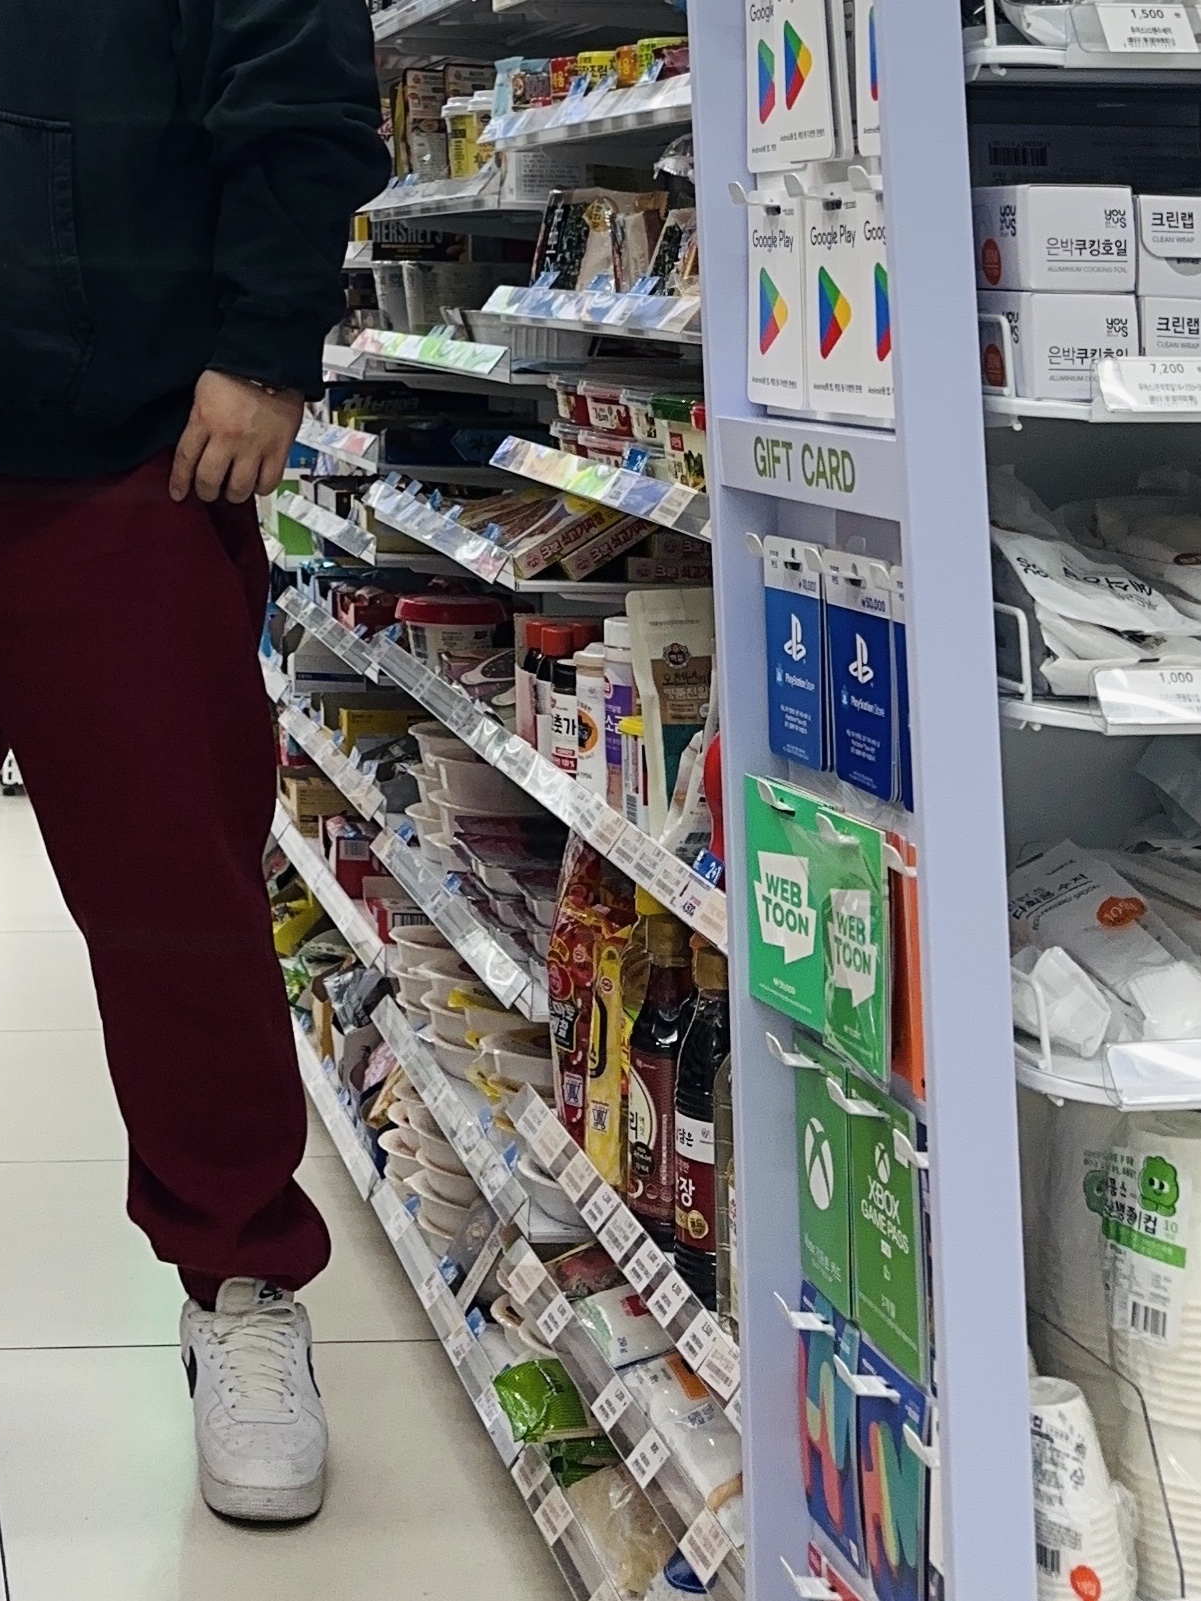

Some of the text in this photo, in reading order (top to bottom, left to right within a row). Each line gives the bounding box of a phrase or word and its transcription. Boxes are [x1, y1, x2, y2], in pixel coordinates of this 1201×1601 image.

[1130, 8, 1165, 20] 1,500
[863, 220, 887, 245] Goog
[1150, 211, 1195, 231] 크린랩
[752, 229, 794, 253] Google Play
[810, 224, 856, 250] Google Play
[1045, 237, 1128, 258] 은박쿠킹호일
[1151, 235, 1195, 244] CLEAN WRAP
[1156, 316, 1200, 335] 크린랩
[1149, 362, 1185, 375] 7,200
[753, 435, 856, 494] GIFT CARD
[1158, 671, 1194, 685] 1,000
[764, 872, 803, 908] WEB
[761, 898, 810, 936] TOON
[836, 911, 866, 946] WEB
[833, 937, 872, 977] TOON
[867, 1175, 901, 1225] XBOX
